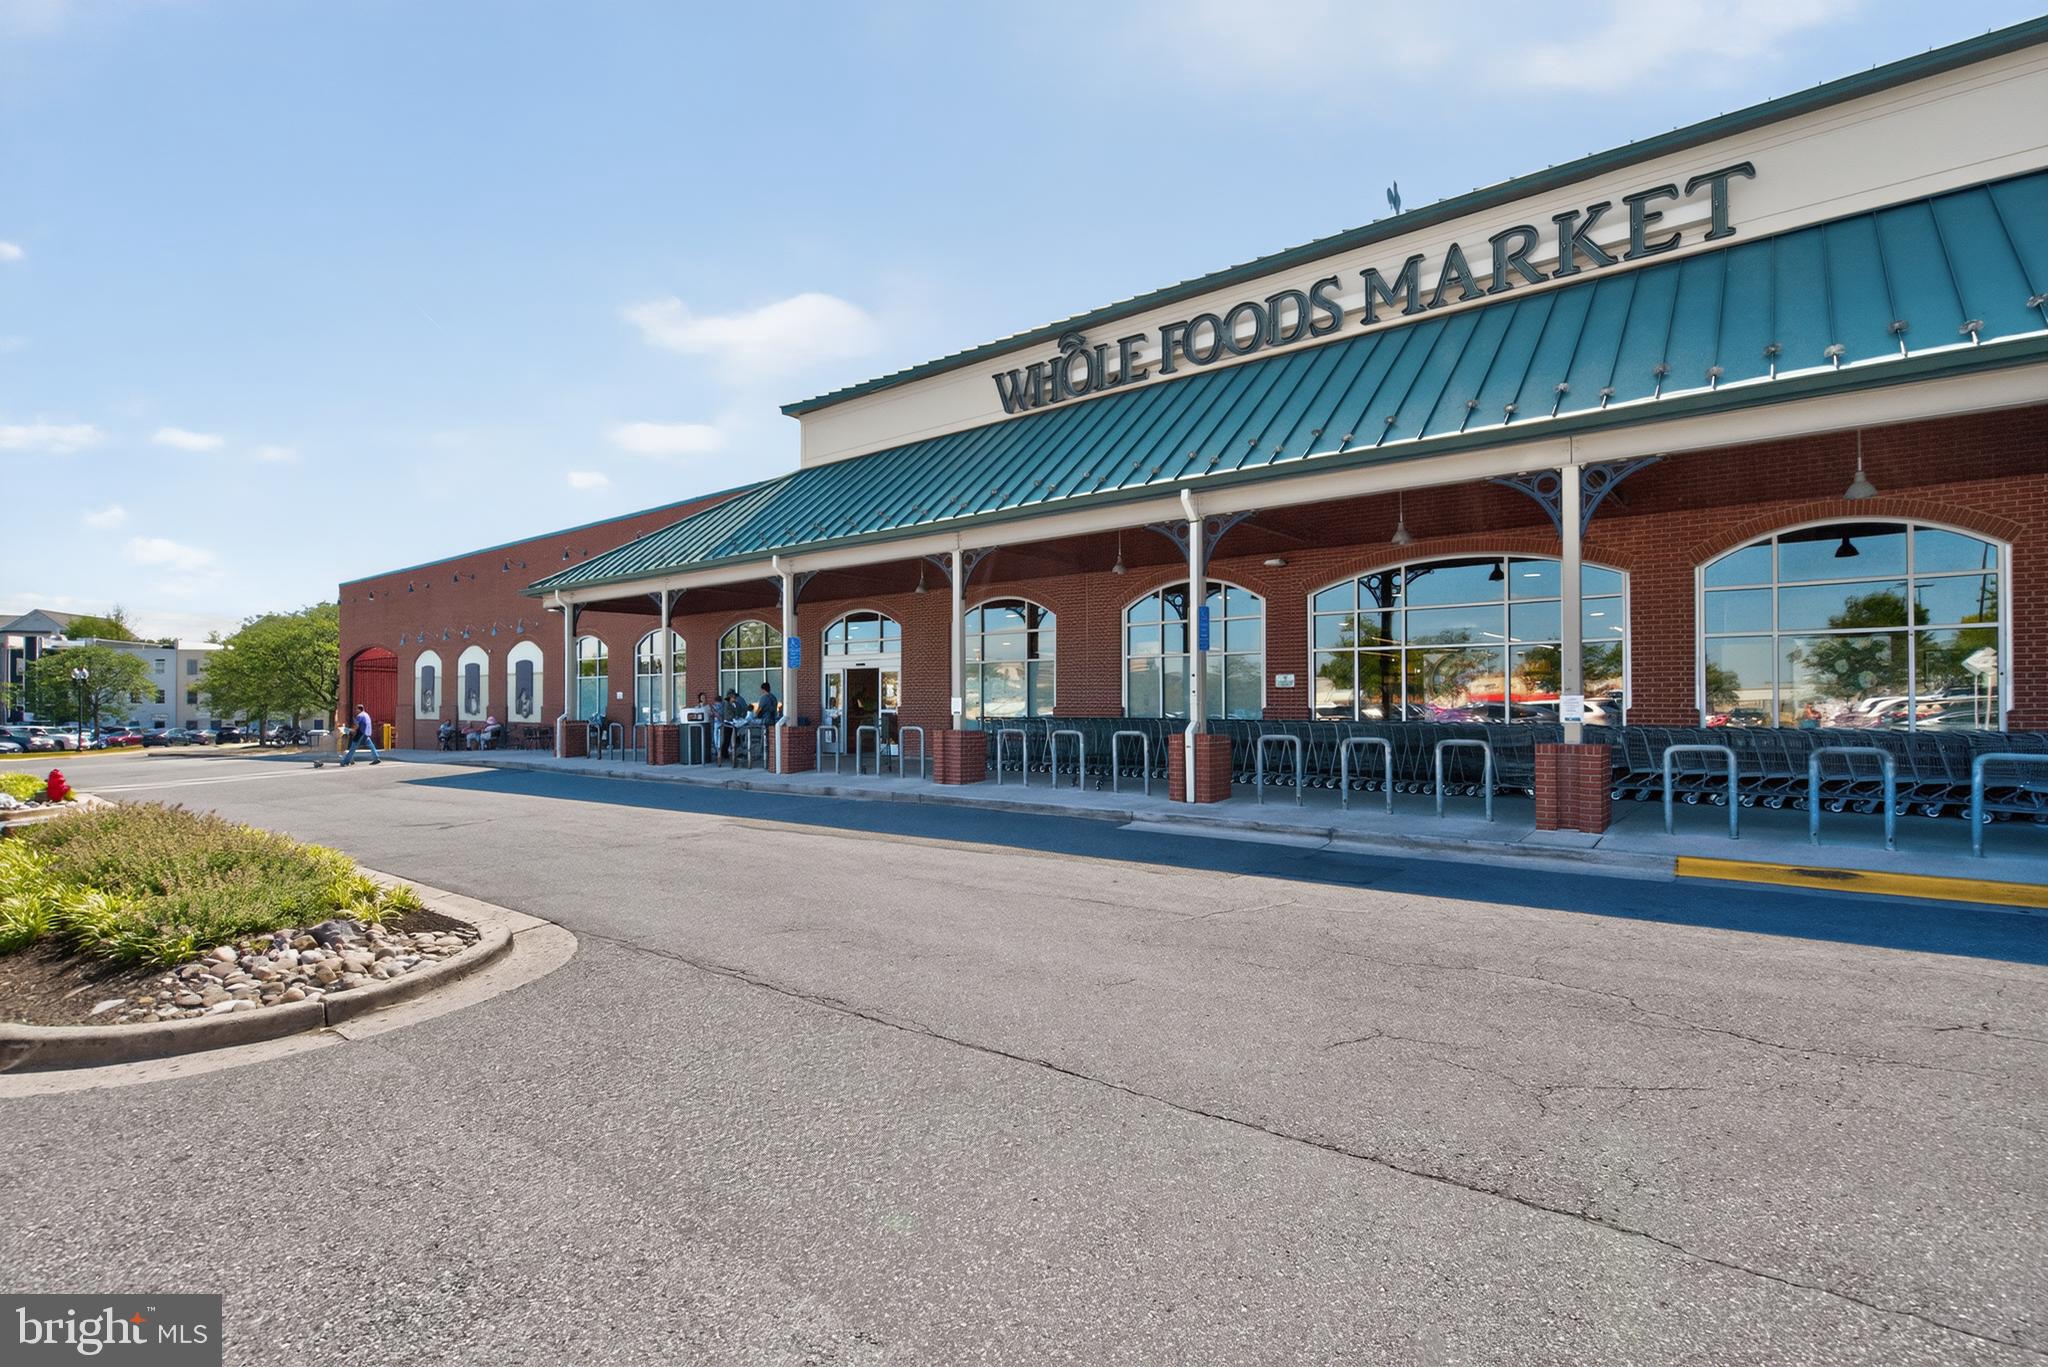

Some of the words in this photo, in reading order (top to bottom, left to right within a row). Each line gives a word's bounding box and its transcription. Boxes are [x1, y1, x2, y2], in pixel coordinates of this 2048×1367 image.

[992, 331, 1150, 414] WHOLE
[1158, 275, 1344, 375] FOODS
[1359, 161, 1757, 325] MARKET
